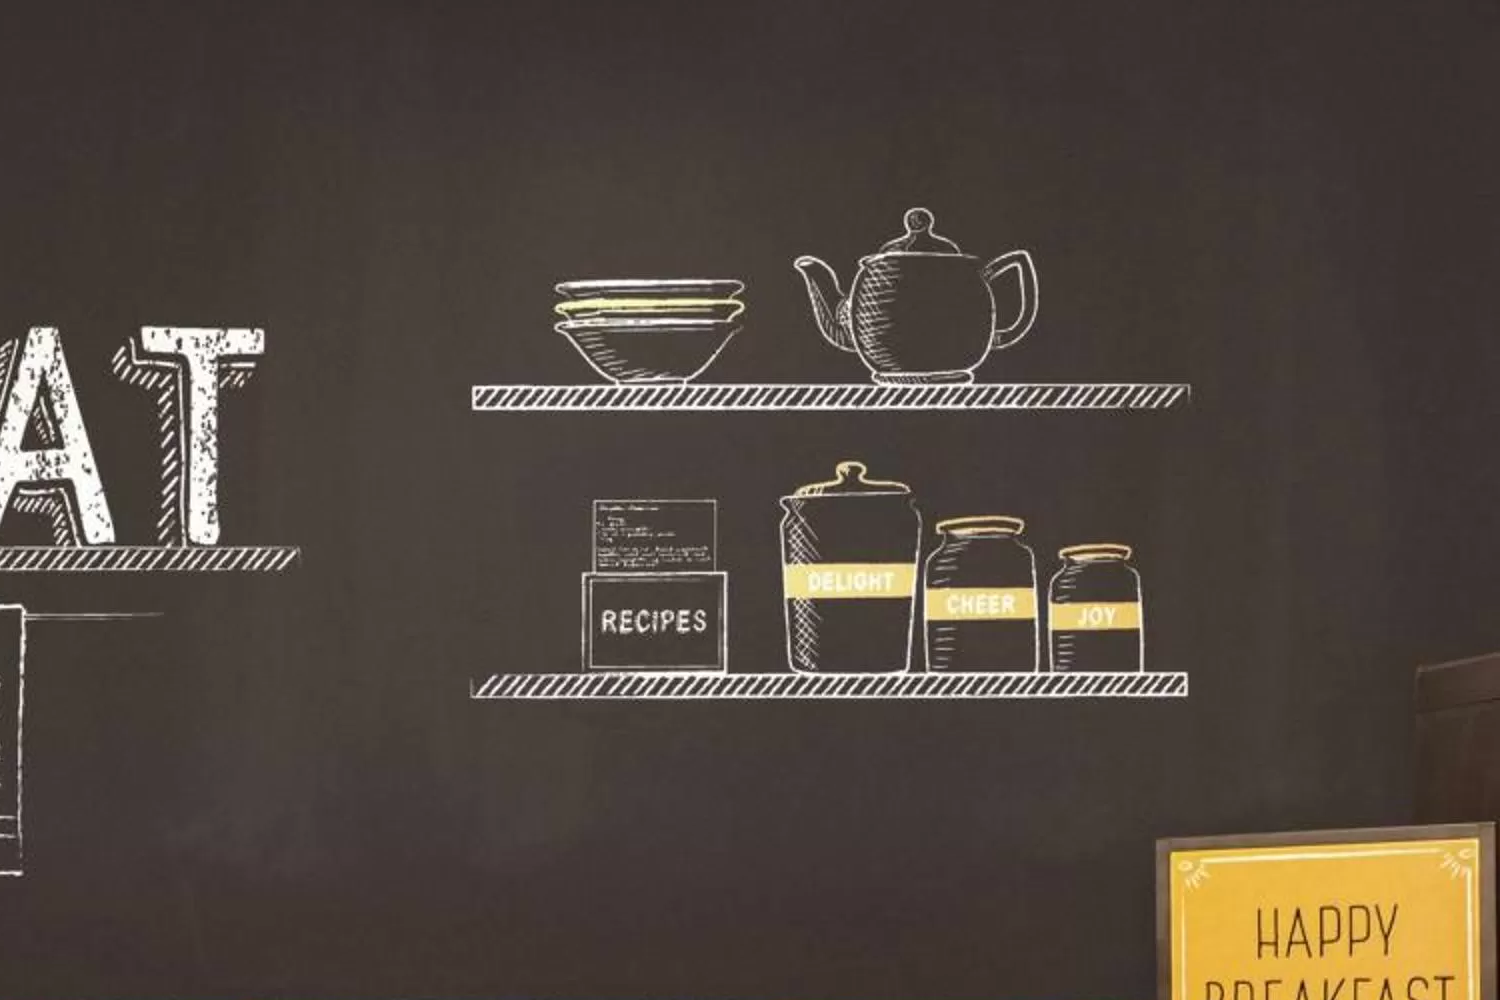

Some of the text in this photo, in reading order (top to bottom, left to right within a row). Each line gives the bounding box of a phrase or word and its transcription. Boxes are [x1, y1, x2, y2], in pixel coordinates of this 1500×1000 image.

[807, 571, 895, 592] DELIGHT
[947, 593, 1016, 616] CHEER
[601, 609, 707, 634] RECIPES
[1077, 606, 1116, 627] JOY
[1257, 904, 1399, 960] HAPPY
